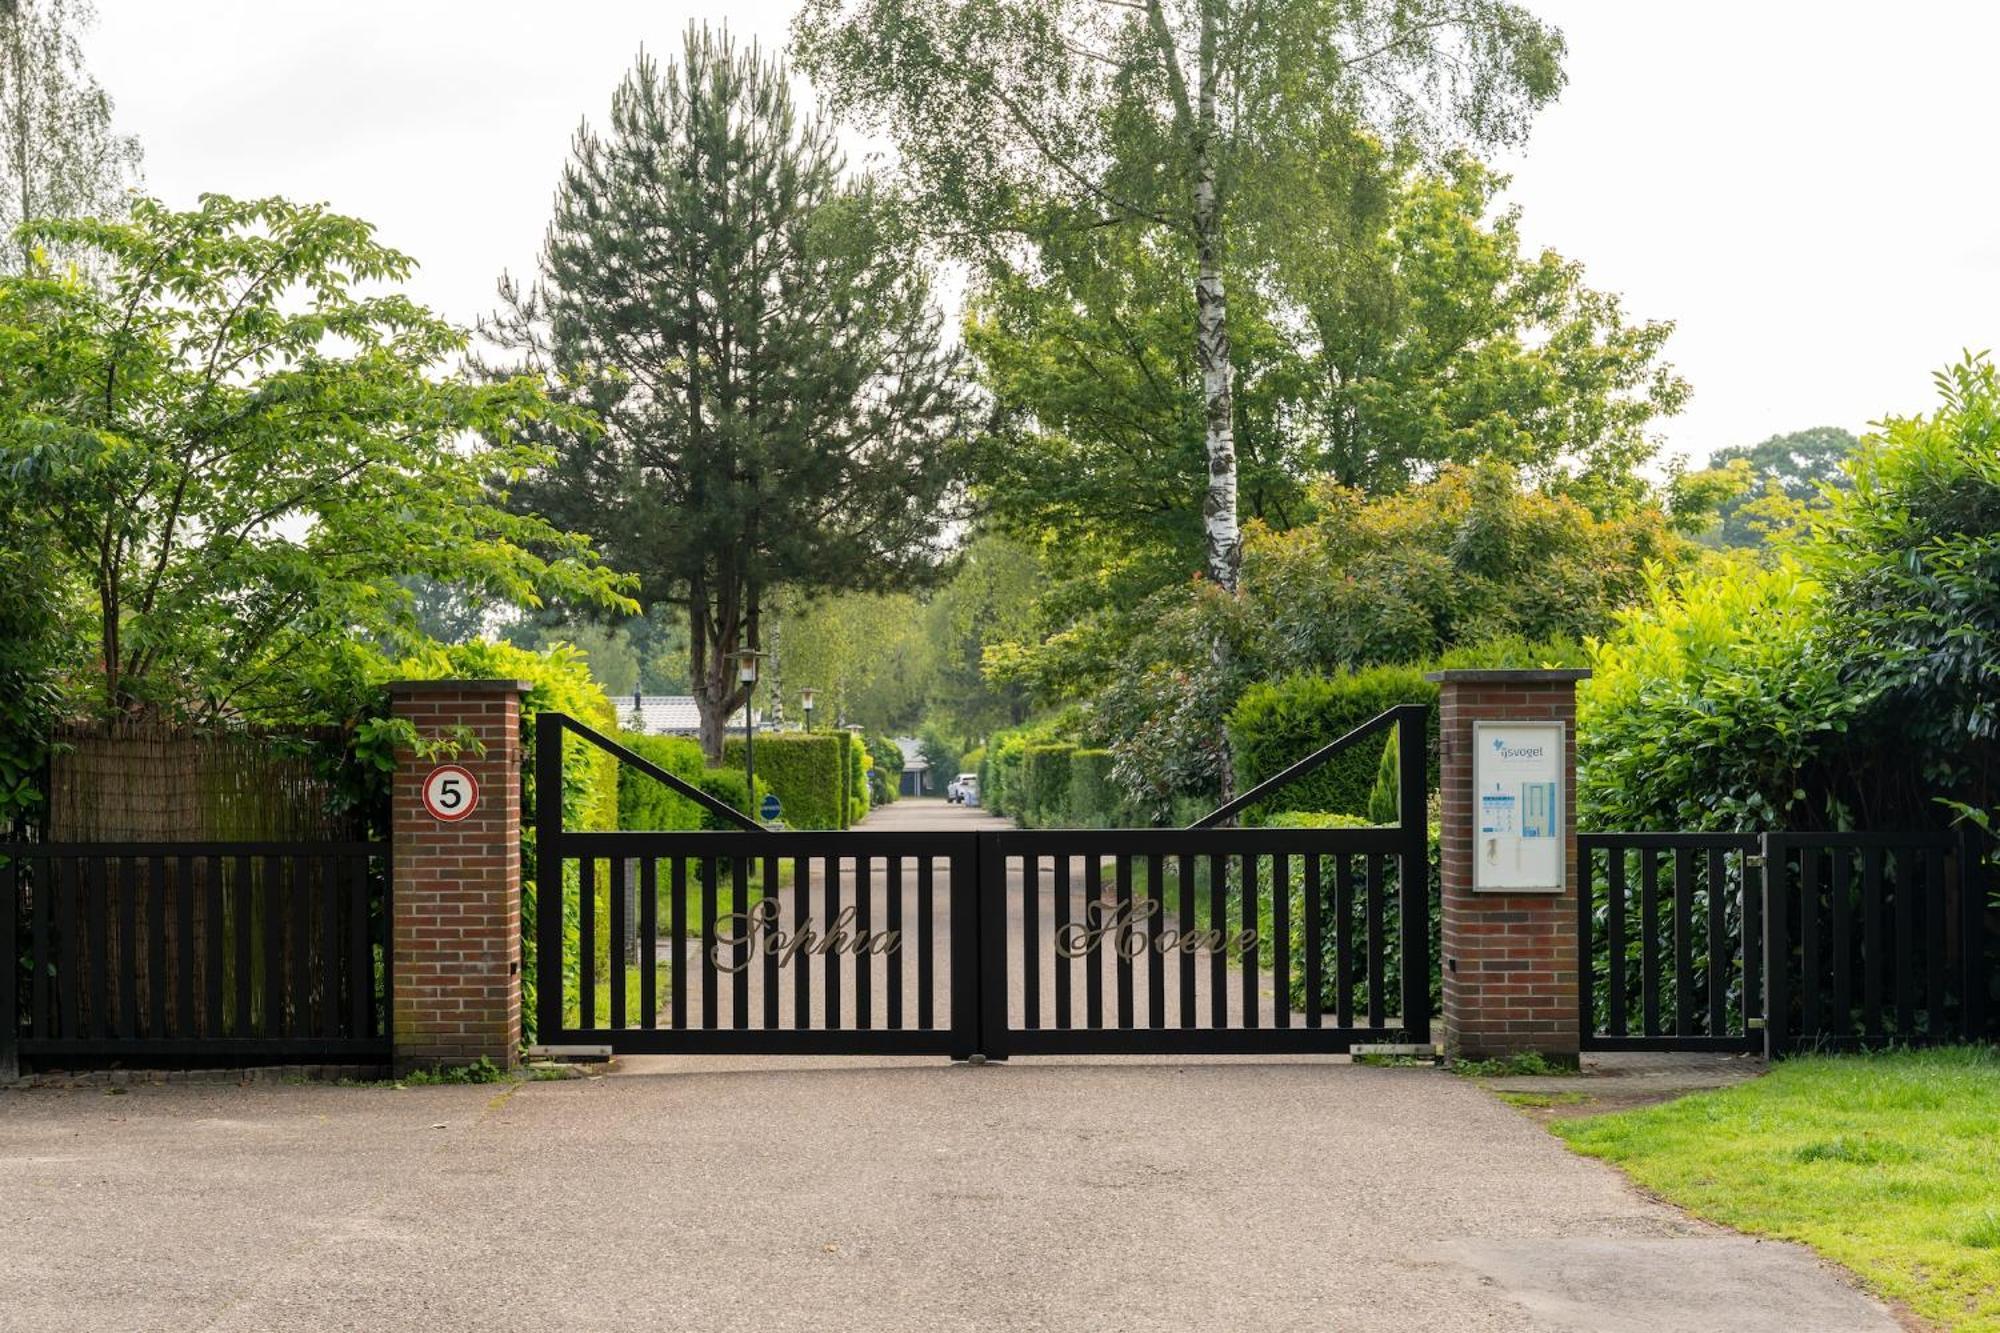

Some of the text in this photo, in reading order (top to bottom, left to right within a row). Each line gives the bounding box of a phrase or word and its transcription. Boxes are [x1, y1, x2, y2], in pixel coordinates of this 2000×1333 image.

[439, 779, 461, 809] 5
[710, 897, 1260, 973] Sophia Hoeve
